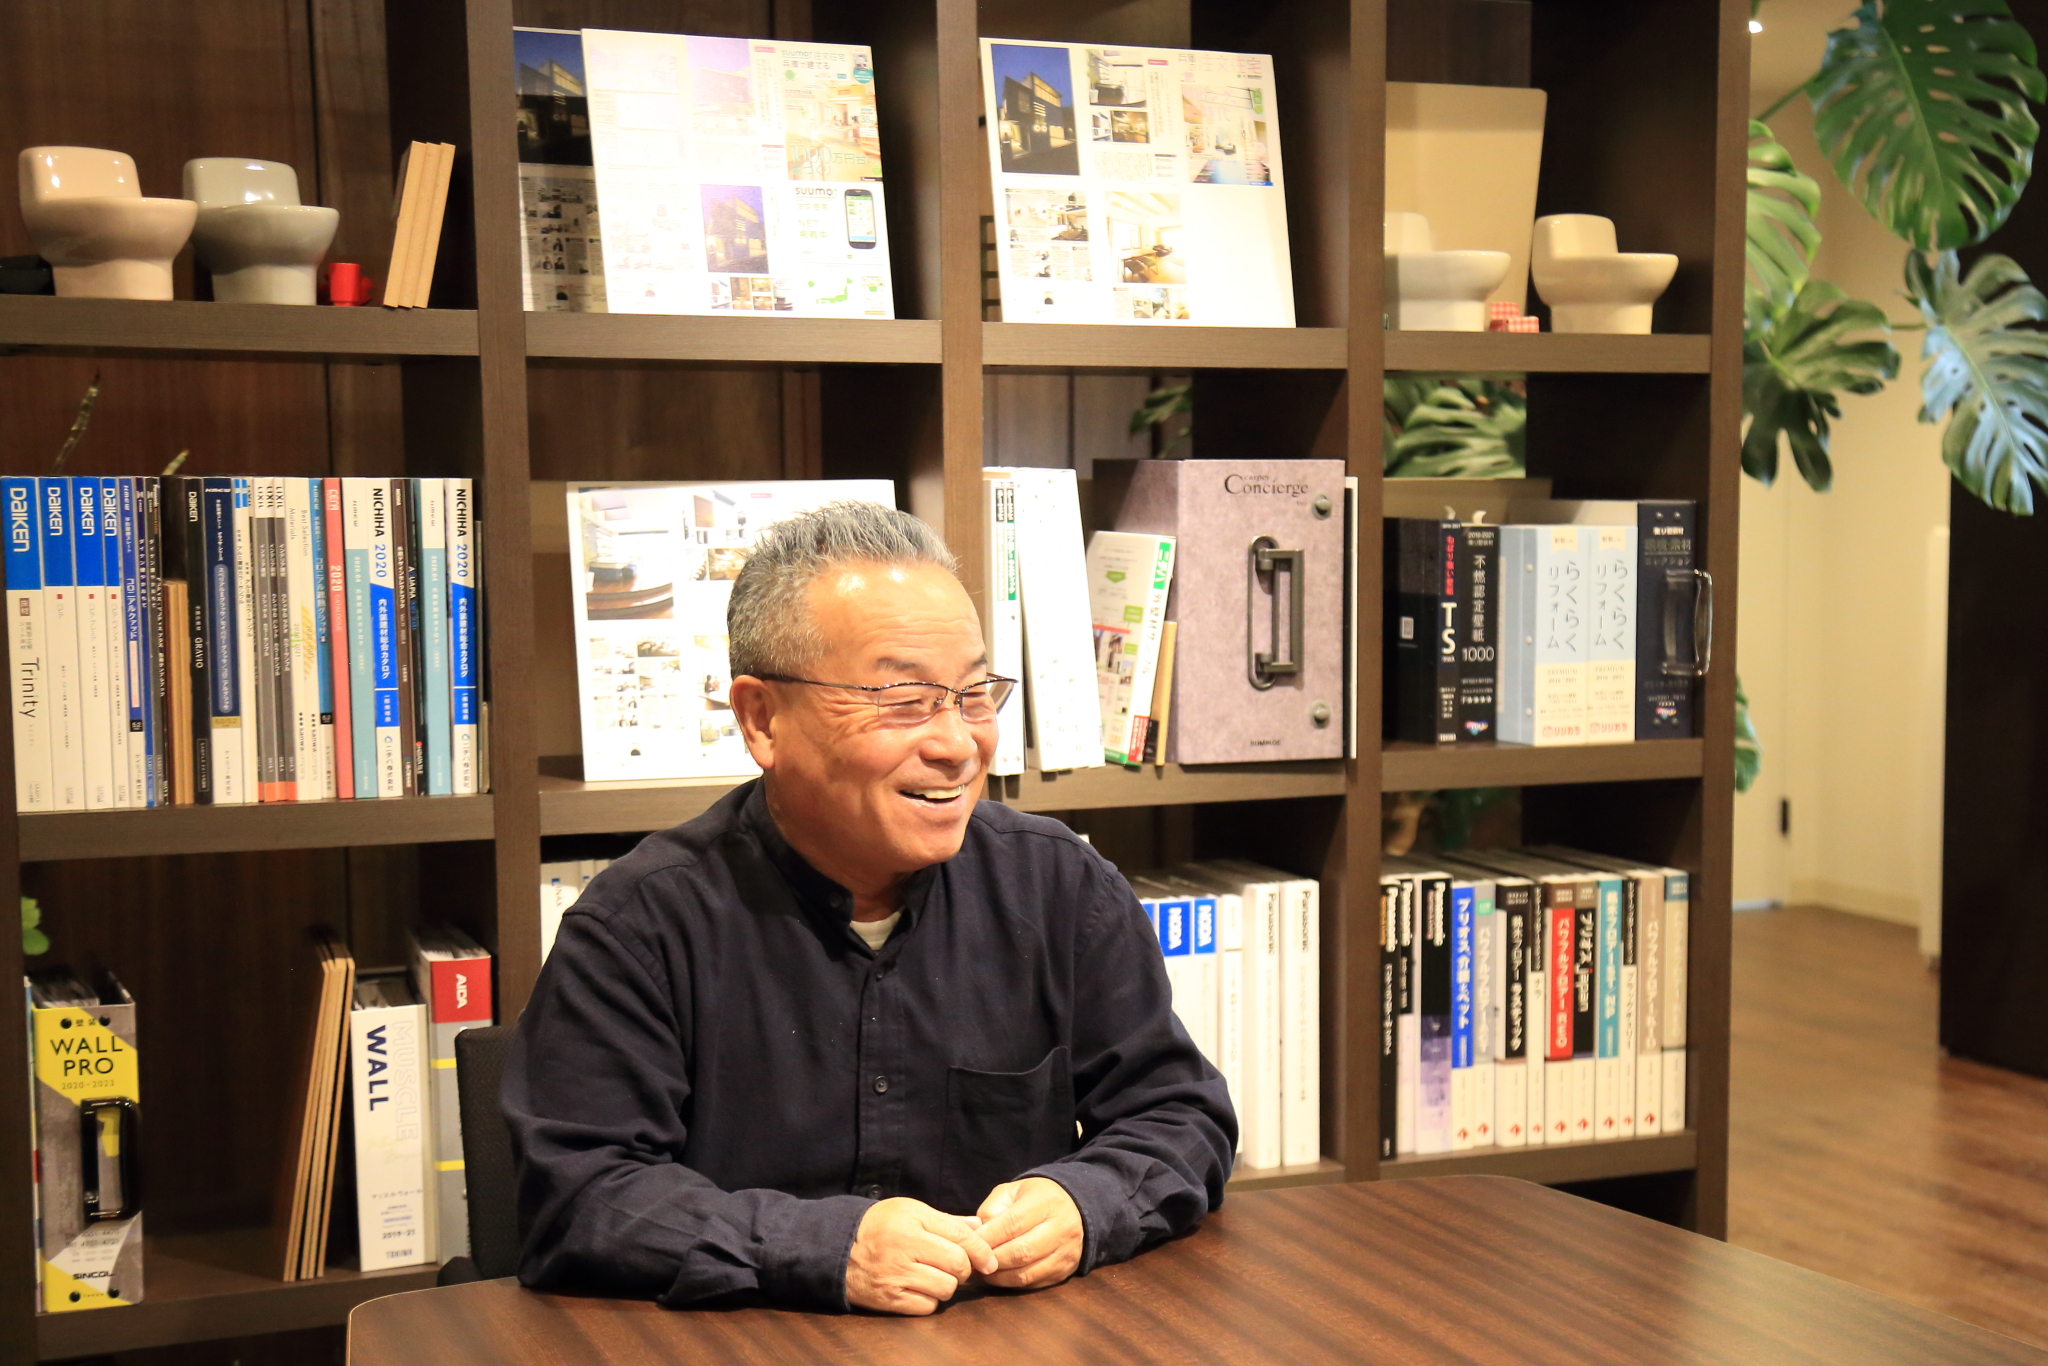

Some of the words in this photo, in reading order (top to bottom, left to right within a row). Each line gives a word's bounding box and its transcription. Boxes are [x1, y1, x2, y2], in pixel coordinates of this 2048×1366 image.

[795, 187, 834, 196] suumo
[1224, 474, 1309, 498] Concierge
[289, 508, 297, 540] Materials
[373, 488, 385, 537] NICHIHA
[457, 488, 467, 537] NICHIHA
[302, 526, 310, 557] Selection
[374, 544, 387, 578] 2020
[457, 543, 468, 578] 2020
[330, 565, 342, 592] 2020
[1472, 555, 1486, 643] 不燃認定壁紙
[1548, 566, 1560, 649] リフォーム
[1566, 560, 1580, 652] らくらく
[1595, 565, 1607, 646] リフォーム
[1613, 559, 1628, 650] らくらく
[194, 637, 204, 669] GRAVIO
[1462, 646, 1494, 662] 1000
[21, 657, 40, 719] Trinity
[1168, 906, 1183, 950] NODA
[1198, 904, 1212, 948] NODA
[1267, 892, 1276, 956] Panasonic
[1301, 889, 1311, 953] Panasonic
[1575, 963, 1593, 1013] japan
[51, 1035, 123, 1055] WALL
[61, 1080, 115, 1090] 2020-2023
[64, 1058, 114, 1077] PRO
[366, 1024, 390, 1112] WALL
[392, 1020, 419, 1141] MUSCLE
[73, 1270, 116, 1281] SINCOL
